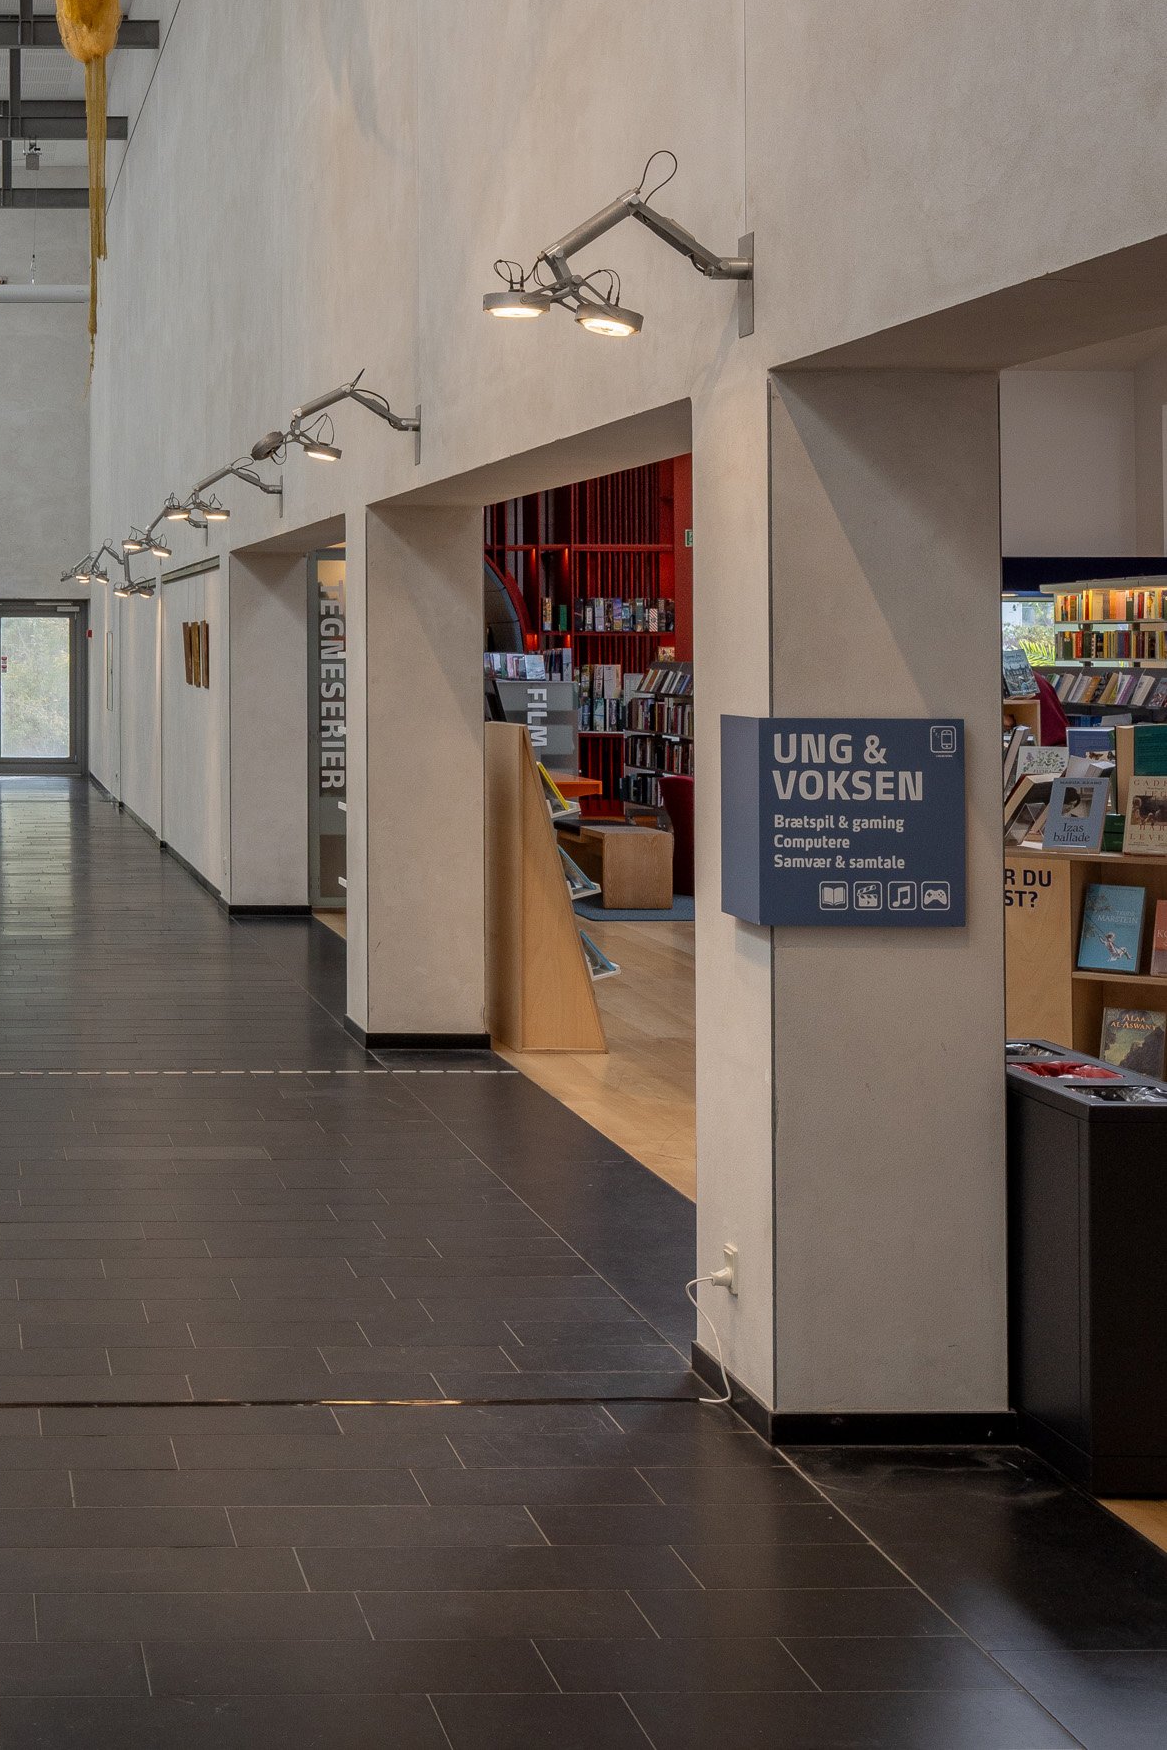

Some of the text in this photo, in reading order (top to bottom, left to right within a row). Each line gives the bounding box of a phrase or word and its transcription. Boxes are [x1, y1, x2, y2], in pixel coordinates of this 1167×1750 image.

[319, 580, 345, 789] TEGNESERIER
[527, 688, 548, 747] FILM
[773, 733, 887, 764] UNG &
[772, 770, 923, 801] VOKSEN
[774, 814, 905, 833] Brætspil & gaming
[774, 835, 850, 851] Computere
[1053, 832, 1091, 842] ballade
[774, 854, 906, 869] Samvær & samtale
[1023, 869, 1052, 887] DU
